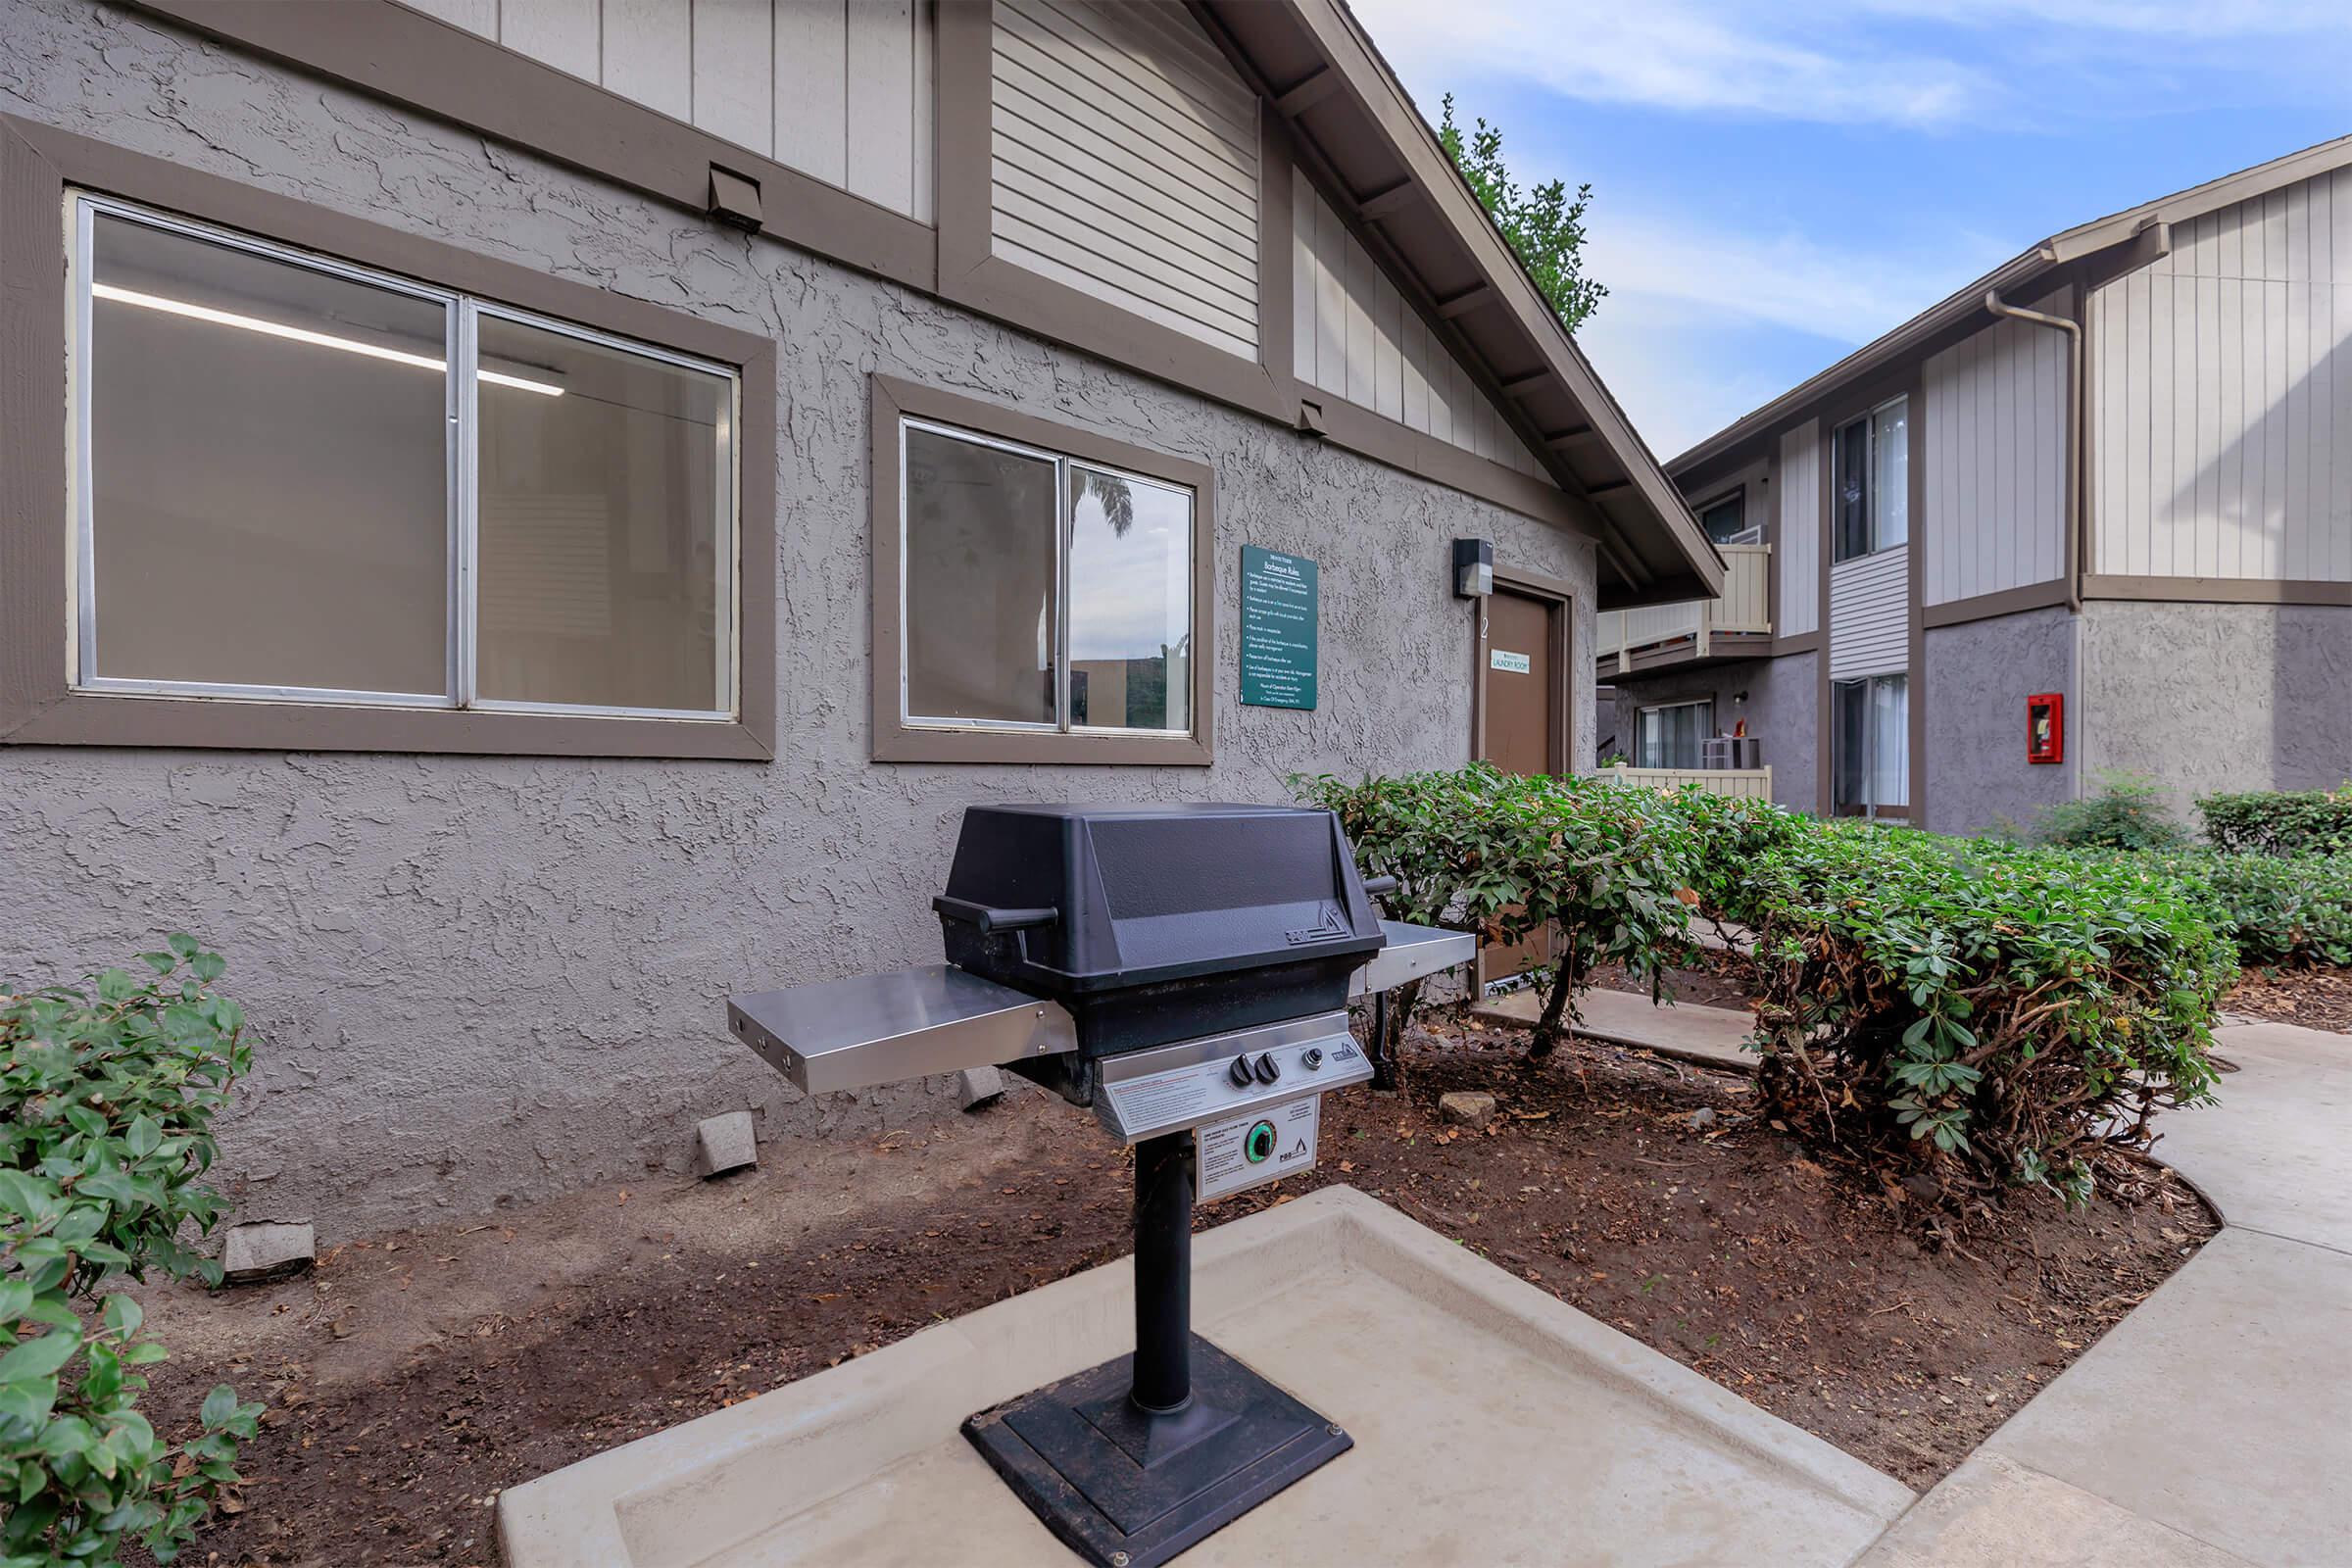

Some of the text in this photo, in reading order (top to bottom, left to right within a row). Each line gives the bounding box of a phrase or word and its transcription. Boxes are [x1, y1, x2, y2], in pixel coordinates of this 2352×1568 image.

[1264, 561, 1299, 576] Barbeque Rules
[1481, 617, 1489, 638] 2
[1493, 658, 1528, 669] LAUNDRY ROOM
